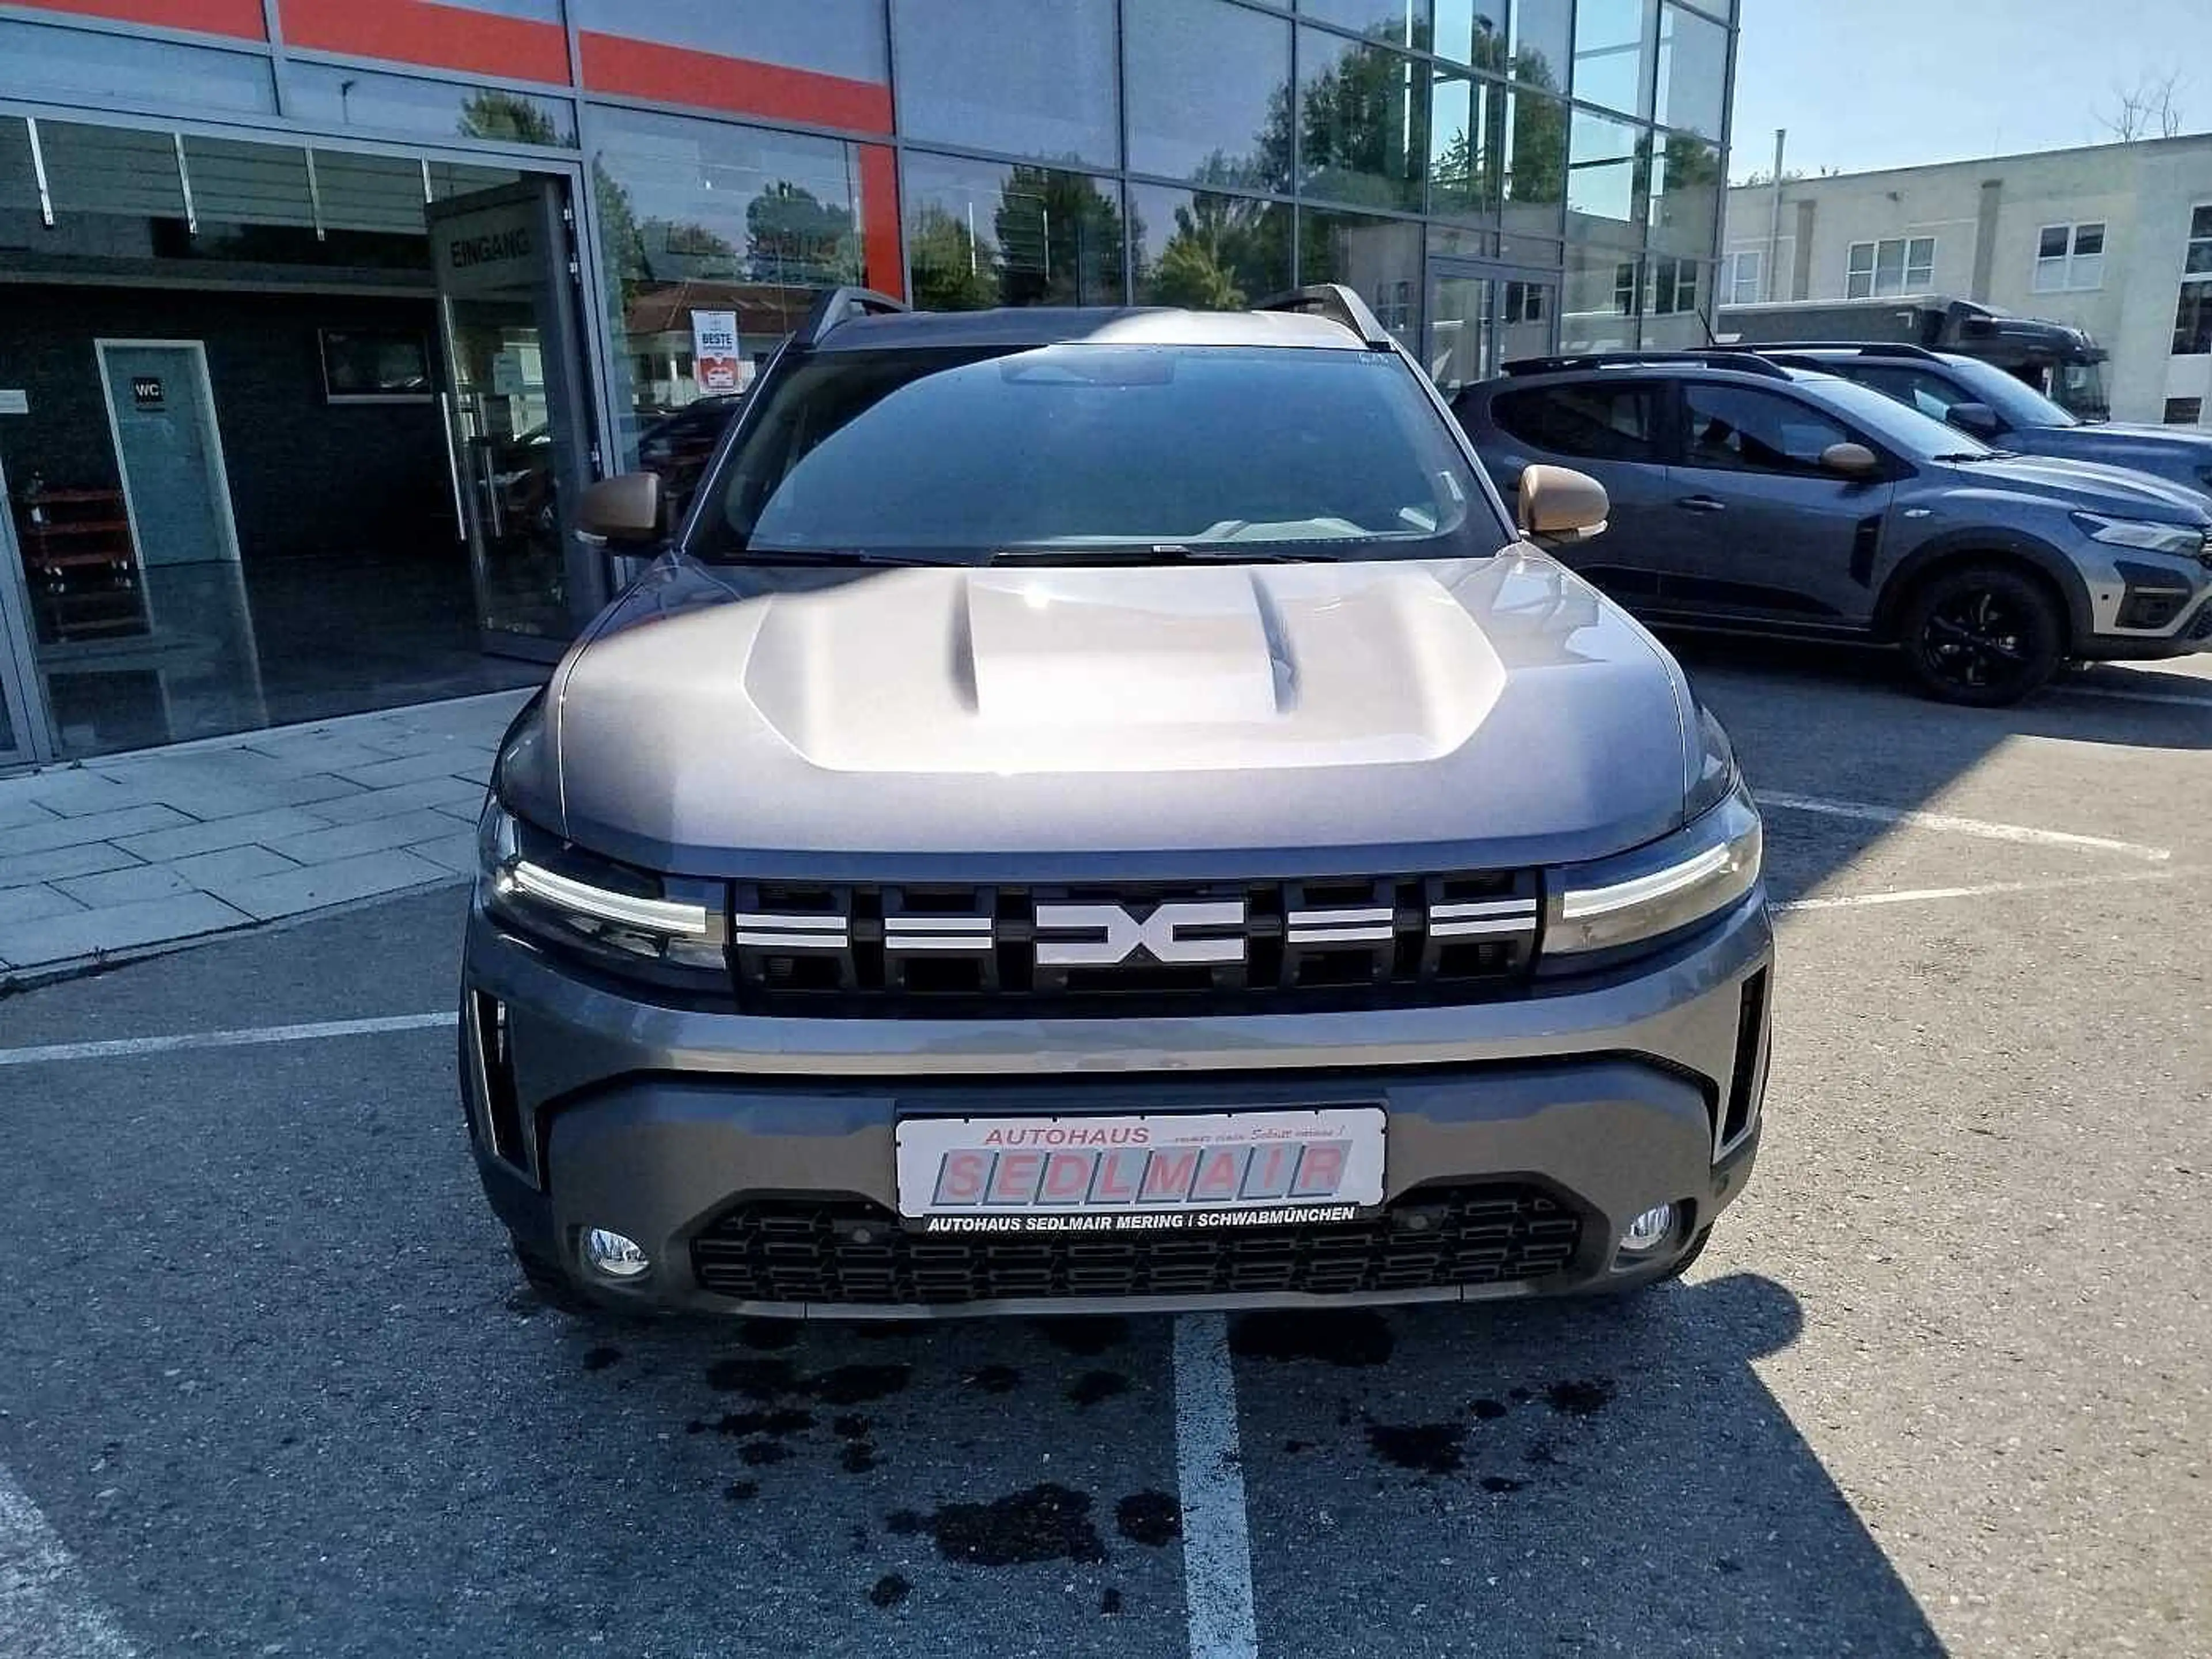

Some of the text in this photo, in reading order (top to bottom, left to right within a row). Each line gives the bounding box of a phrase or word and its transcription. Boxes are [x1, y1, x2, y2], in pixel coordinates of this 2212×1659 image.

[449, 228, 532, 268] EINGANG
[702, 332, 734, 345] BESTE
[135, 382, 160, 396] WC
[985, 1127, 1150, 1145] AUTOHAUS
[945, 1147, 1342, 1197] SEDLMAIR
[928, 1217, 1022, 1232] AUTOHAUS
[1025, 1215, 1112, 1231] SEDLMAIR
[1116, 1214, 1183, 1229] MERING
[1197, 1206, 1355, 1228] SCHWABMÜNCHEN
